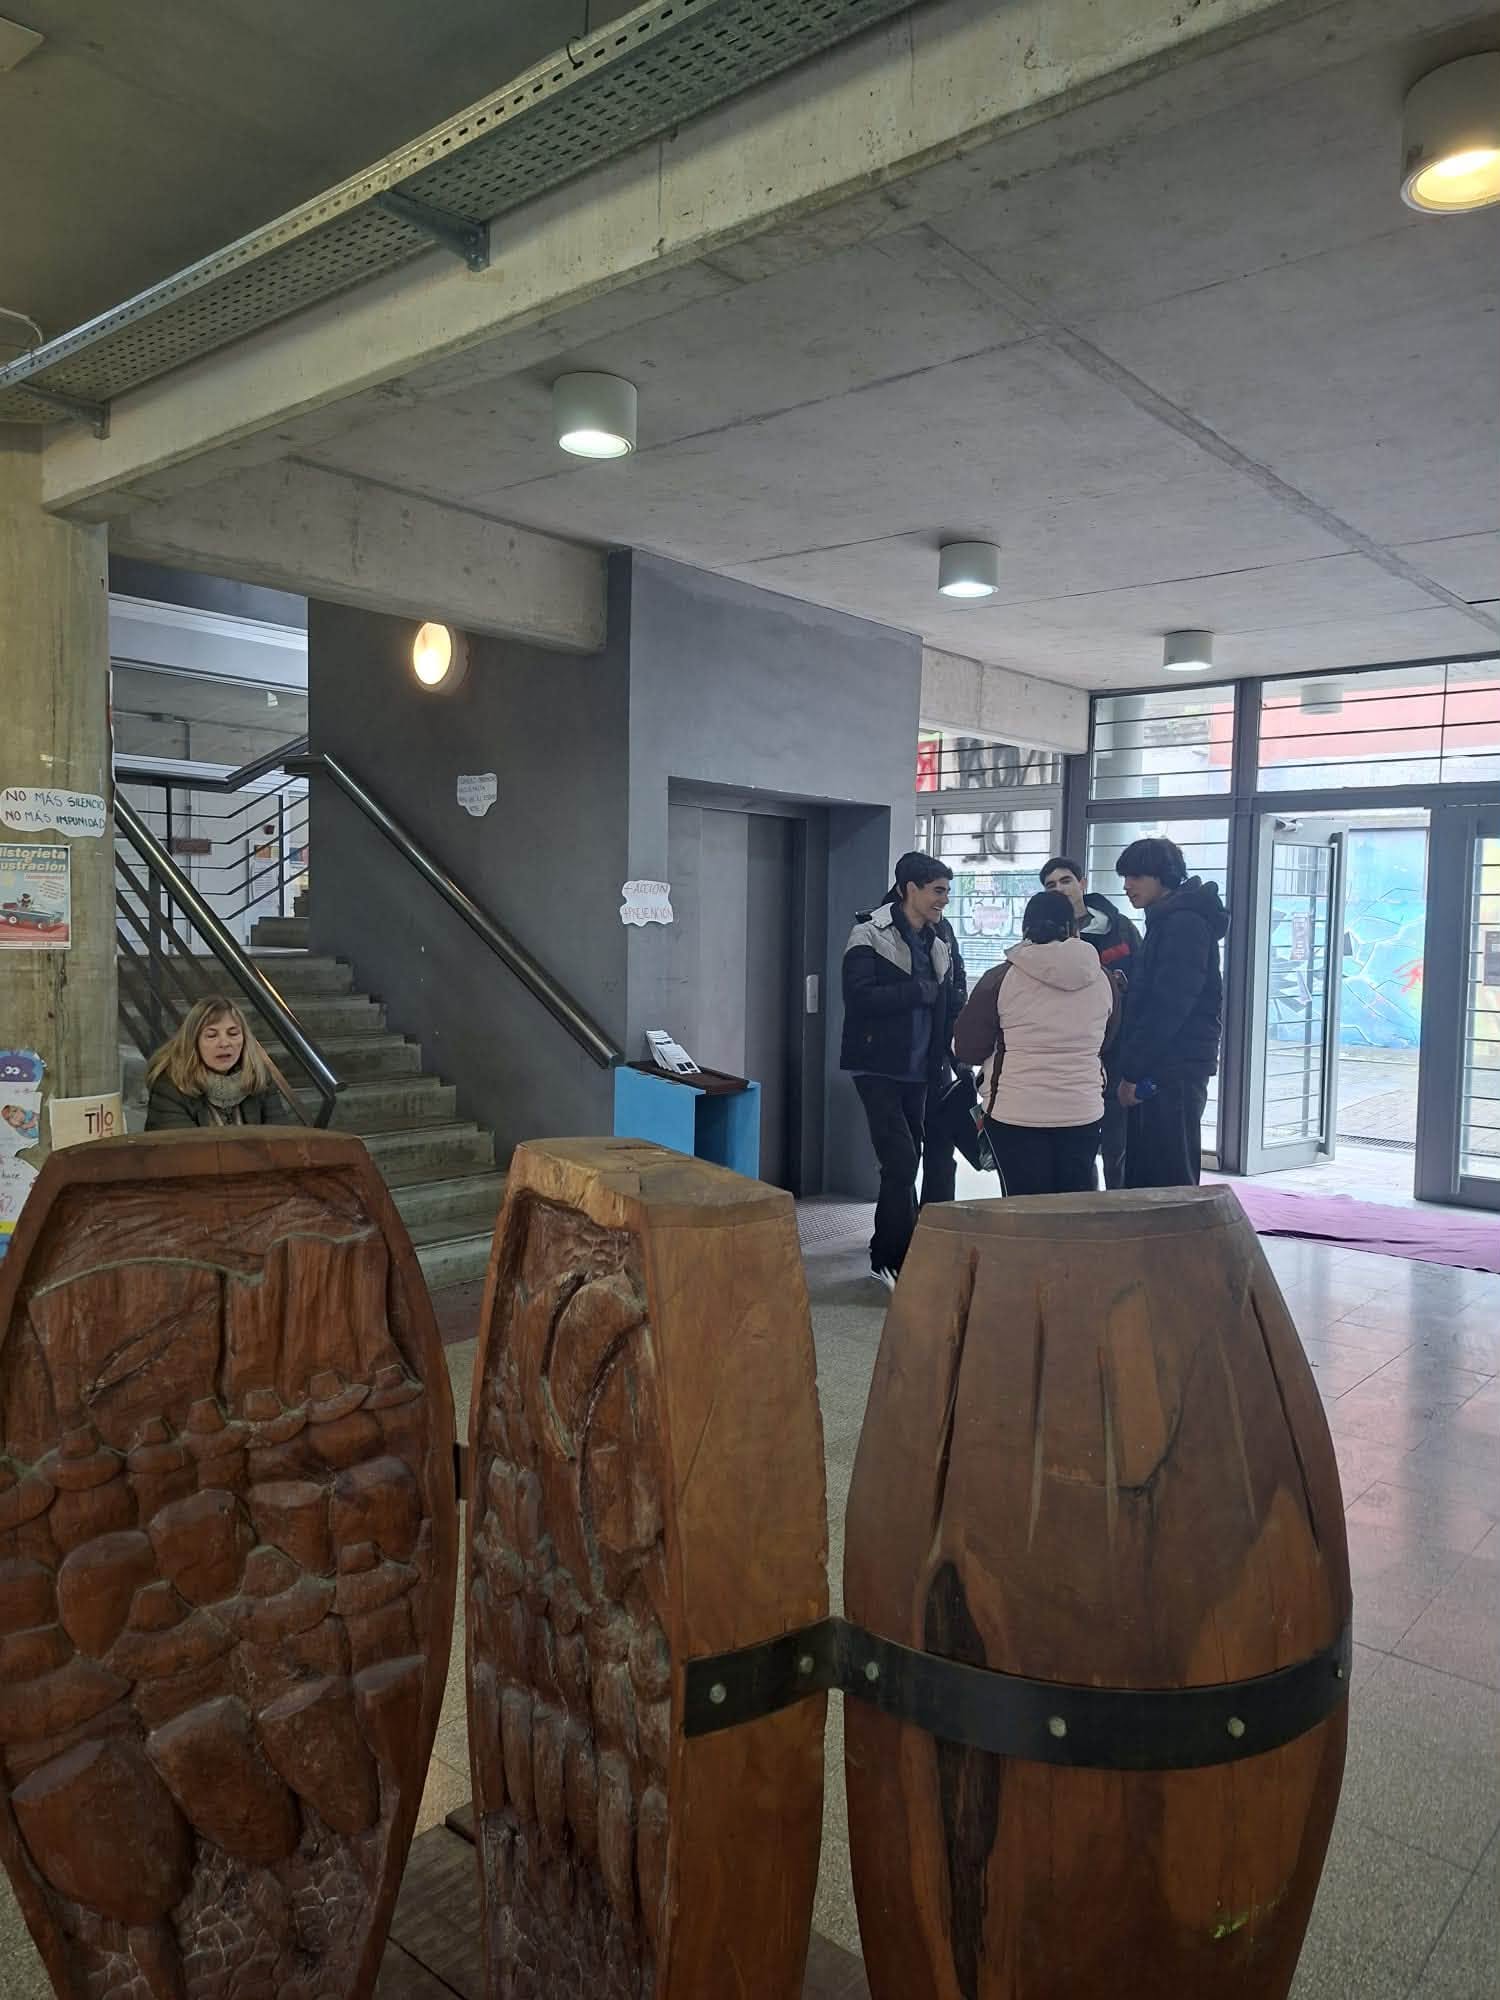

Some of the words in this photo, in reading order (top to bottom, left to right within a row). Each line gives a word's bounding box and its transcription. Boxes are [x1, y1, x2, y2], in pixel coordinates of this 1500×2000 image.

[6, 790, 26, 801] NO
[35, 791, 63, 807] MÁS
[67, 796, 105, 811] SILENCIO
[5, 810, 21, 821] NO
[25, 809, 52, 824] MÁS
[56, 815, 105, 829] IMPUNIDAD
